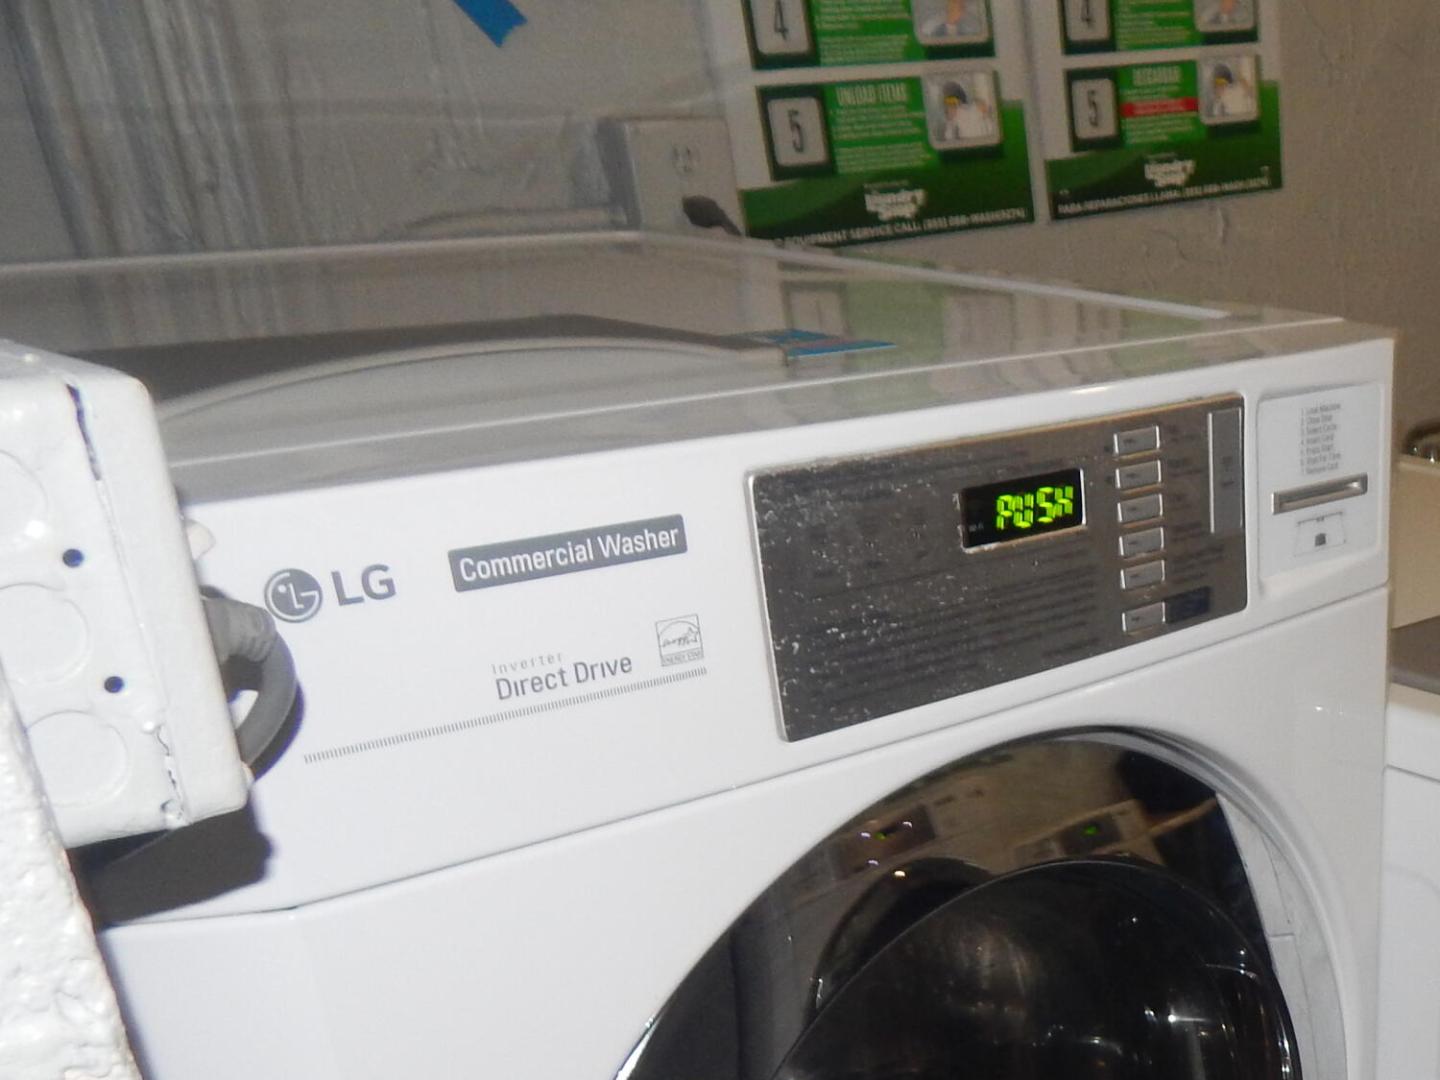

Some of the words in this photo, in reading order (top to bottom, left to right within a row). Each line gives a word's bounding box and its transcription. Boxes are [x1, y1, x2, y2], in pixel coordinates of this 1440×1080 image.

[1087, 89, 1099, 127] 5
[787, 109, 804, 152] 5
[996, 485, 1074, 530] PUSH
[458, 537, 595, 584] Commercial
[598, 524, 680, 559] Washer
[332, 563, 397, 607] LG
[491, 651, 565, 676] Inverter
[496, 667, 568, 701] Direct
[574, 654, 633, 685] Drive
